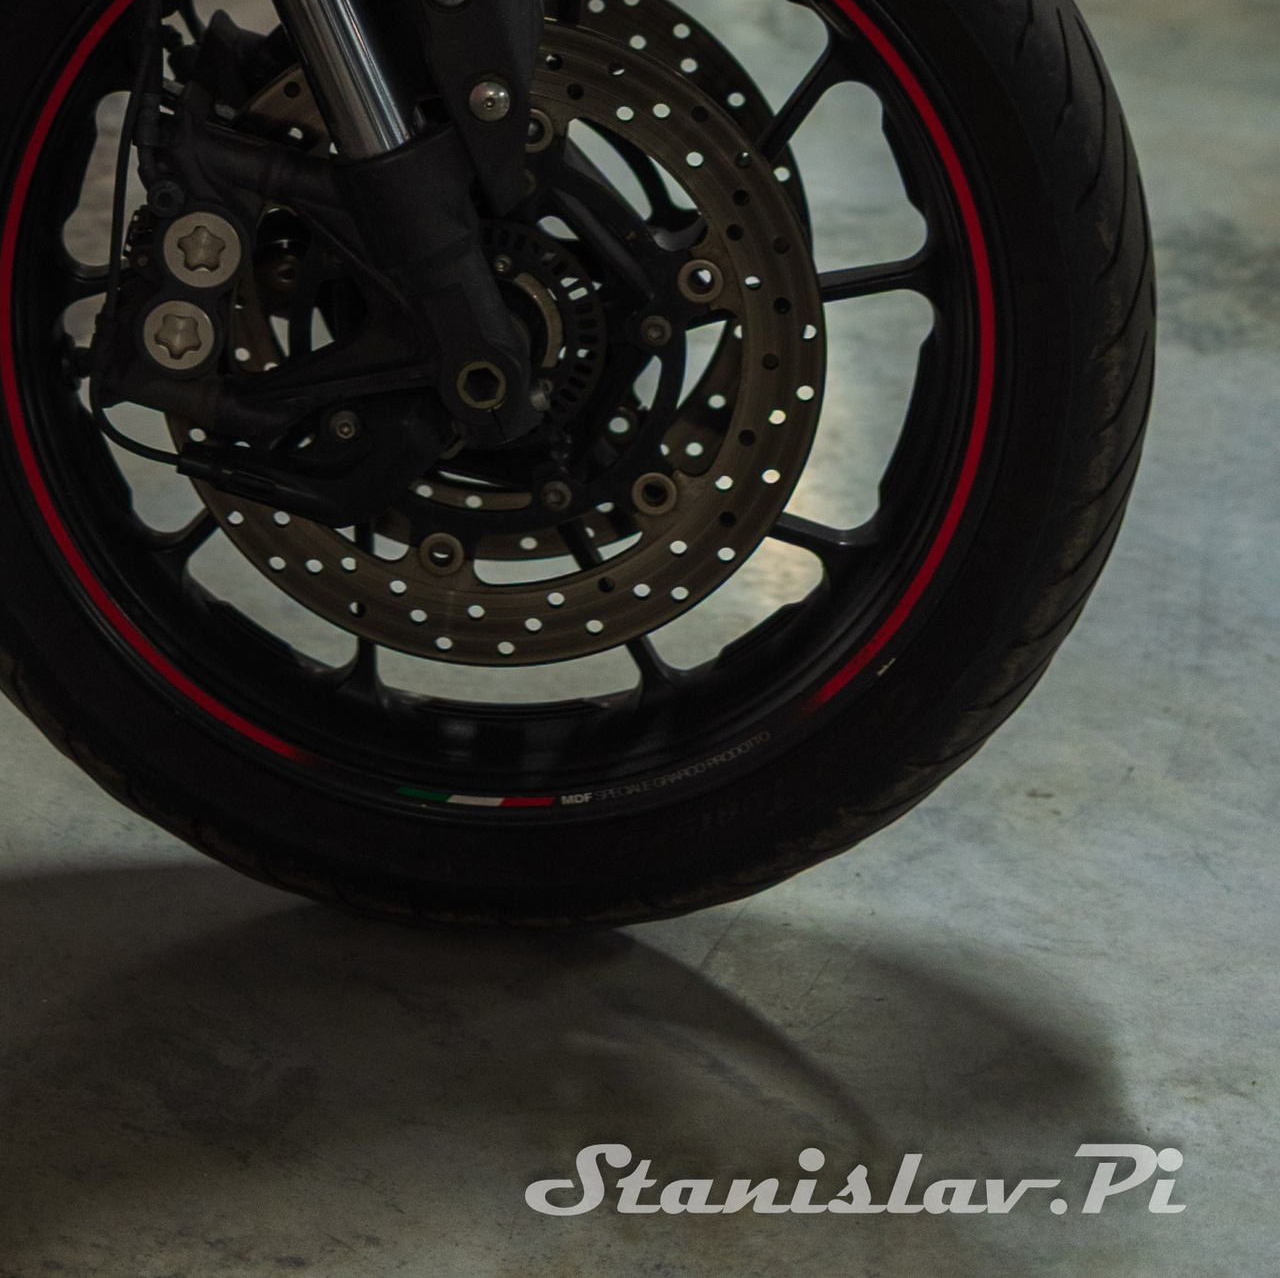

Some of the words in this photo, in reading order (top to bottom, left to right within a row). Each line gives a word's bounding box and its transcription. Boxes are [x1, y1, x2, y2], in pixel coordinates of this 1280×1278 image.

[561, 793, 593, 806] MDF
[595, 780, 652, 802] SPECIALE
[706, 730, 772, 770] PRODOTTO
